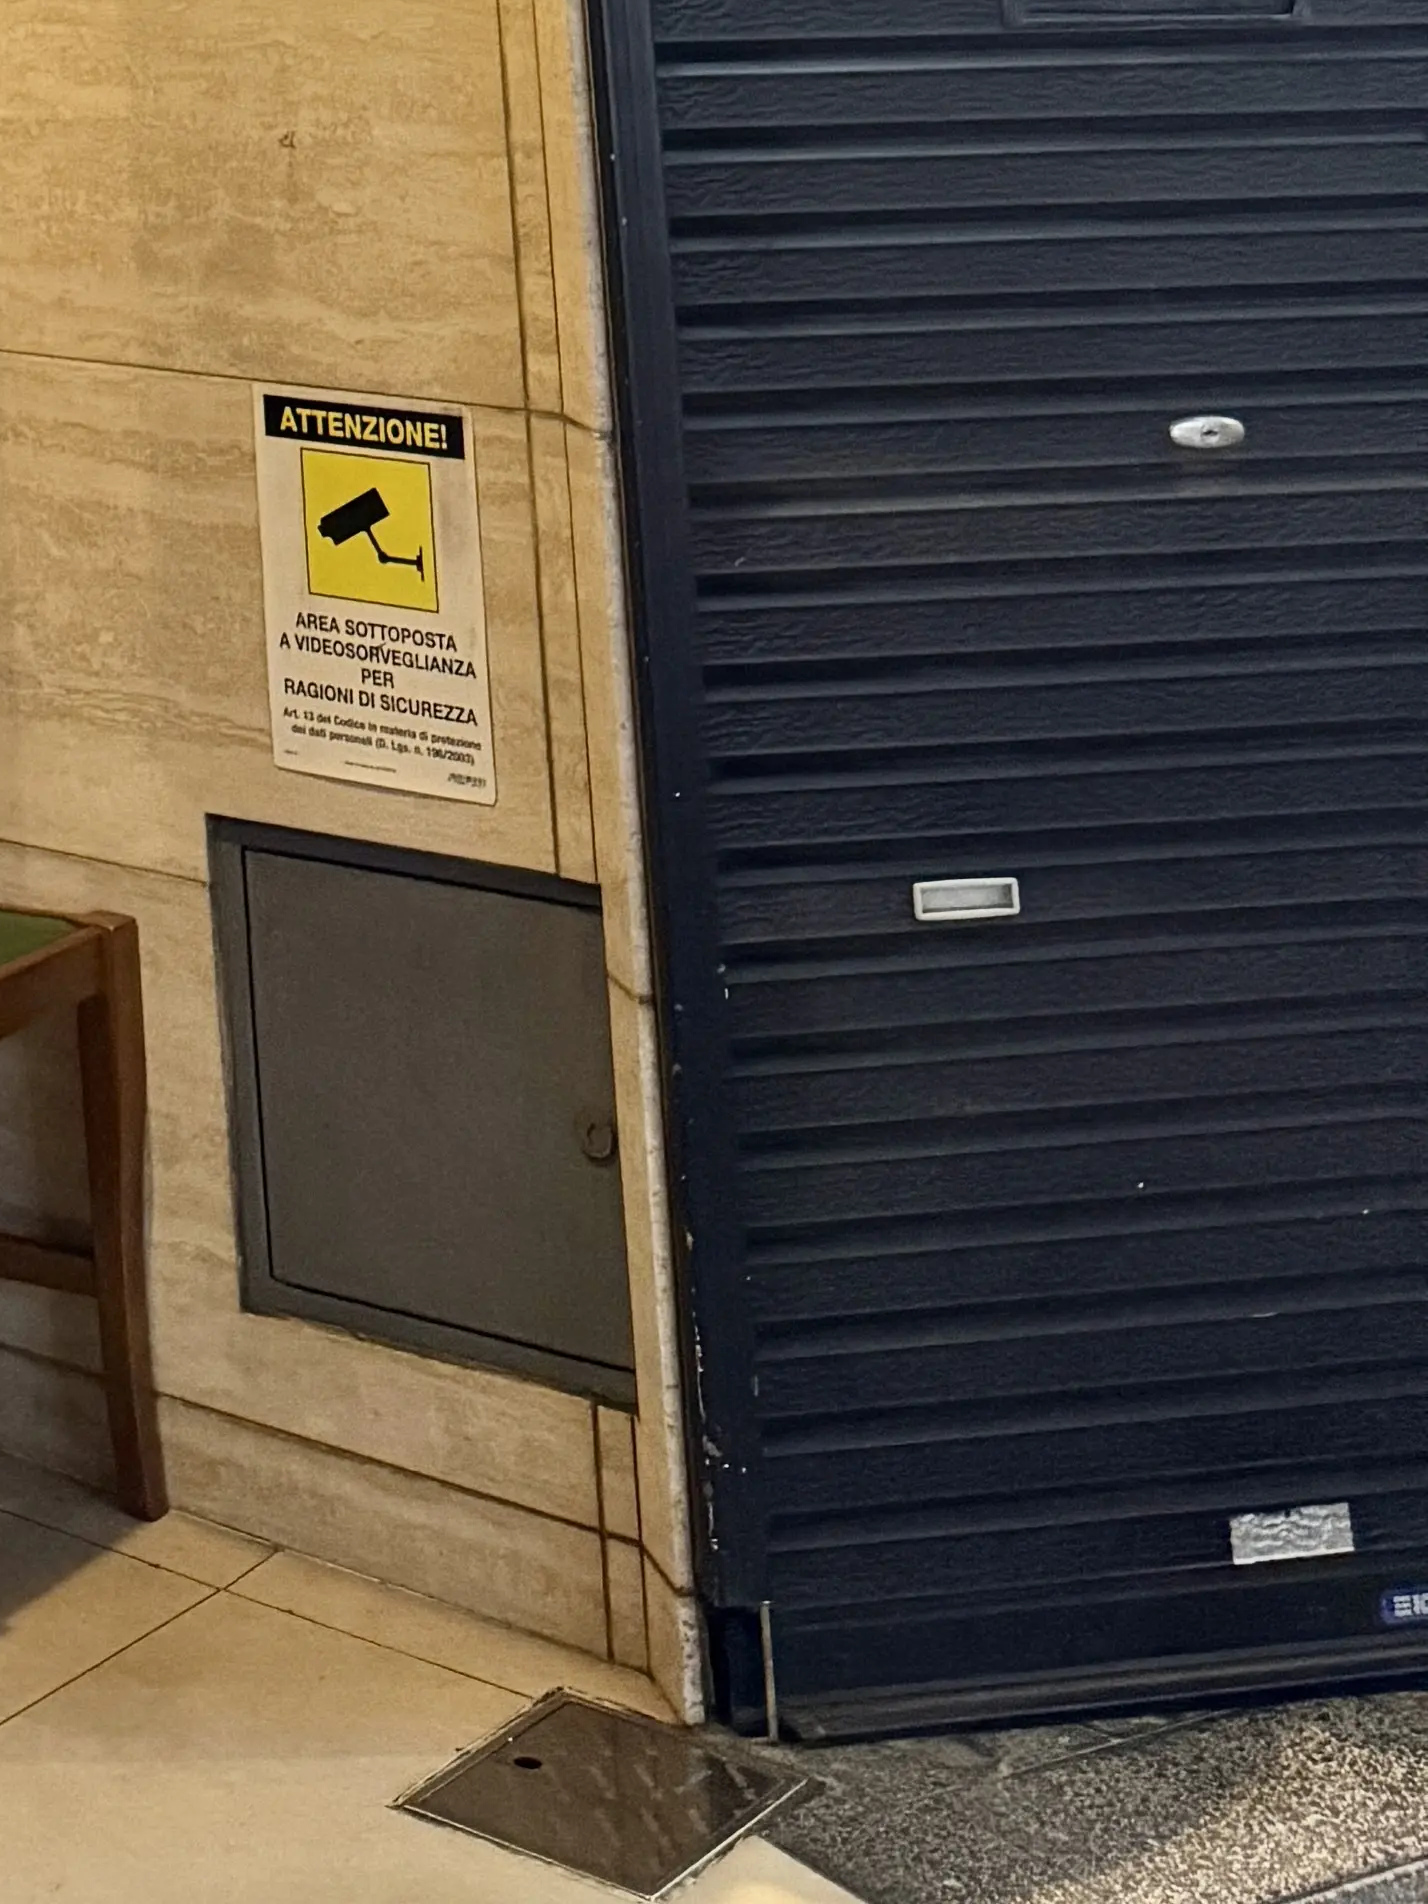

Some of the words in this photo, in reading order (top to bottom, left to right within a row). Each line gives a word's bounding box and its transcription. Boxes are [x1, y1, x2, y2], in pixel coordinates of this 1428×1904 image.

[280, 405, 448, 450] ATTENZIONE!
[296, 611, 341, 634] AREA
[345, 618, 458, 652] SOTTOPOSTA
[279, 631, 291, 649] A
[294, 633, 478, 679] VIDEOSORVEGLIANZA
[361, 667, 395, 689] PER
[284, 677, 354, 705] RAGIONI
[358, 690, 375, 709] DI
[380, 693, 478, 727] SICUREZZA
[283, 706, 300, 719] Art.
[333, 714, 366, 731] Codice
[379, 723, 417, 740] materia
[419, 729, 429, 741] di
[430, 733, 482, 752] protezione
[308, 725, 327, 739] dati
[329, 729, 373, 747] personali
